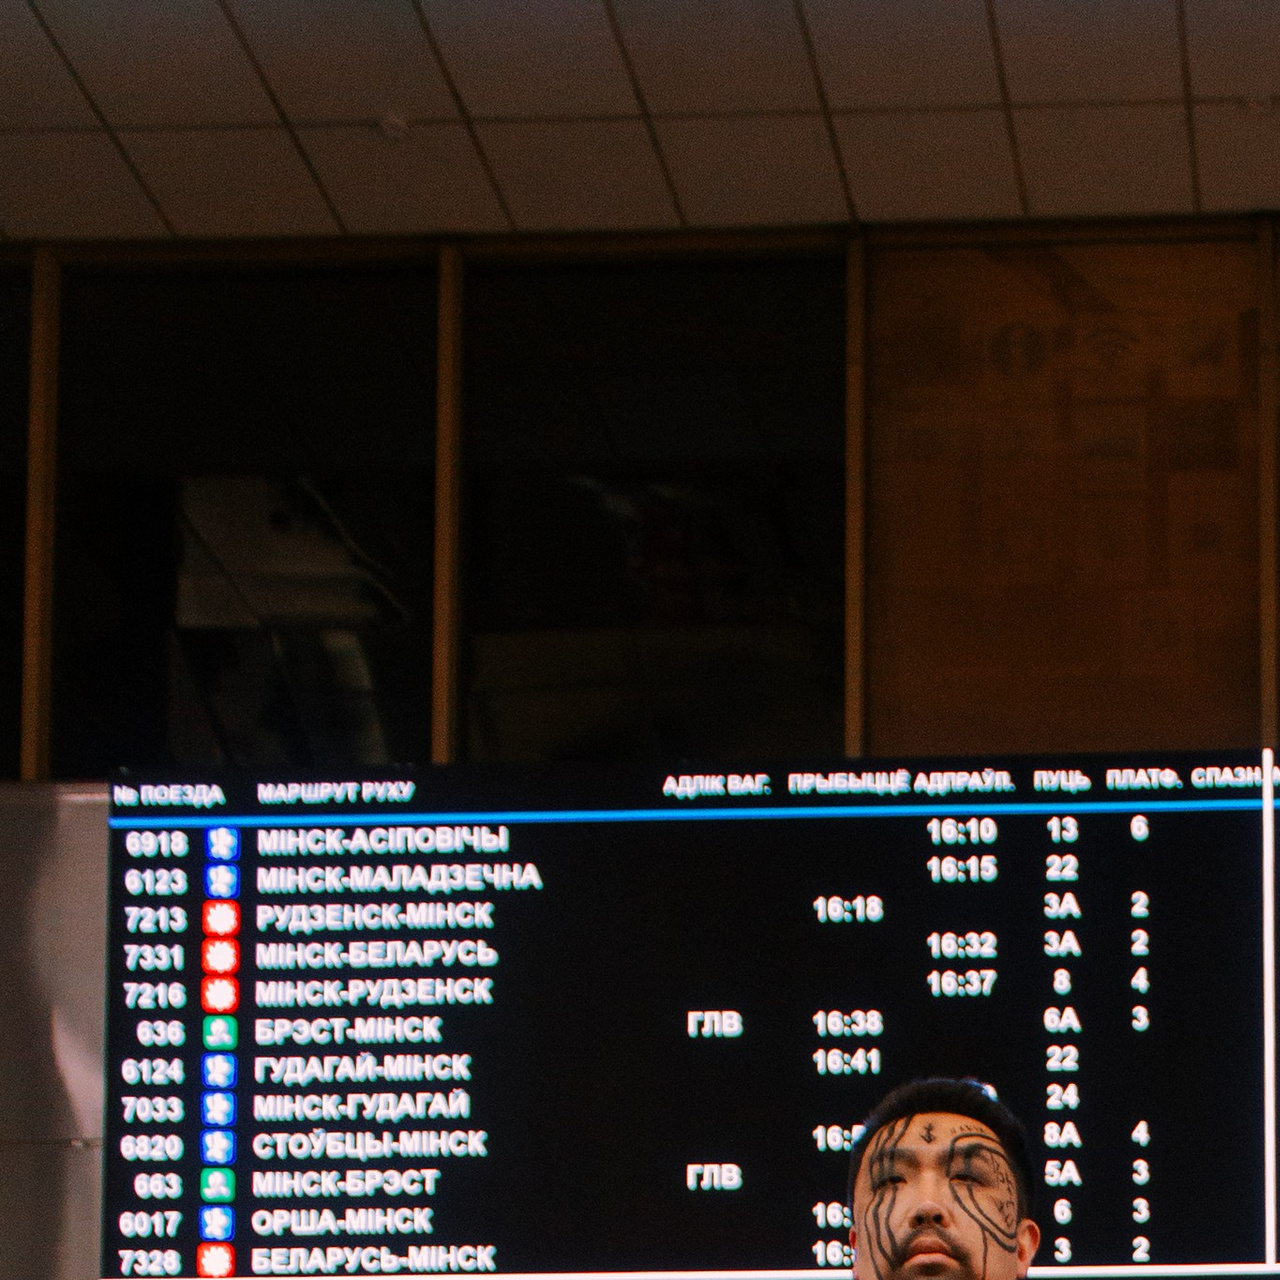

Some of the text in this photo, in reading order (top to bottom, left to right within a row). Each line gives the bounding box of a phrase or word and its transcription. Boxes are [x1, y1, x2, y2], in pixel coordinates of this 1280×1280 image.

[257, 782, 360, 804] МАРШРУТ
[361, 781, 416, 803] РУХУ
[1033, 770, 1092, 794] ПУЦЬ
[126, 815, 1148, 857] 6918 МІНСК-АСІПОВІЧЫ 16:10 13 6
[125, 854, 1078, 895] 6123 МІНСК-МАЛАДЗЕЧНА 16:15 22
[125, 906, 187, 933] 7213
[256, 901, 494, 935] РУДЗЕНСК-МІНСК
[813, 895, 883, 922] 16:18
[124, 944, 184, 970] 7331
[255, 939, 498, 969] МІНСК-БЕЛАРУСЬ
[927, 931, 997, 958] 16:32
[123, 967, 1149, 1009] 7216 МІНСК-РУДЗЕНСК 16:37 8 4
[137, 1020, 185, 1046] 636
[255, 1016, 442, 1045] БРЭСТ-МІНСК
[687, 1010, 743, 1037] ГЛВ
[812, 1009, 883, 1036] 16:38
[121, 1045, 1078, 1086] 6124 ГУДАГАЙ-МІНСК 16:41 22
[121, 1083, 1079, 1123] 7033 МІНСК-ГУДАГАЙ 24
[120, 1134, 184, 1161] 6820
[252, 1128, 487, 1162] СТОЎБЦЫ-МІНСК
[133, 1172, 182, 1199] 663
[252, 1168, 441, 1197] МІНСК-БРЭСТ
[686, 1163, 742, 1190] ГЛВ
[1132, 1159, 1149, 1185] 3
[118, 1198, 1071, 1237] 6017 ОРША-МІНСК 6
[118, 1236, 1071, 1275] 7328 БЕЛАРУСЬ-МІНСК 3
